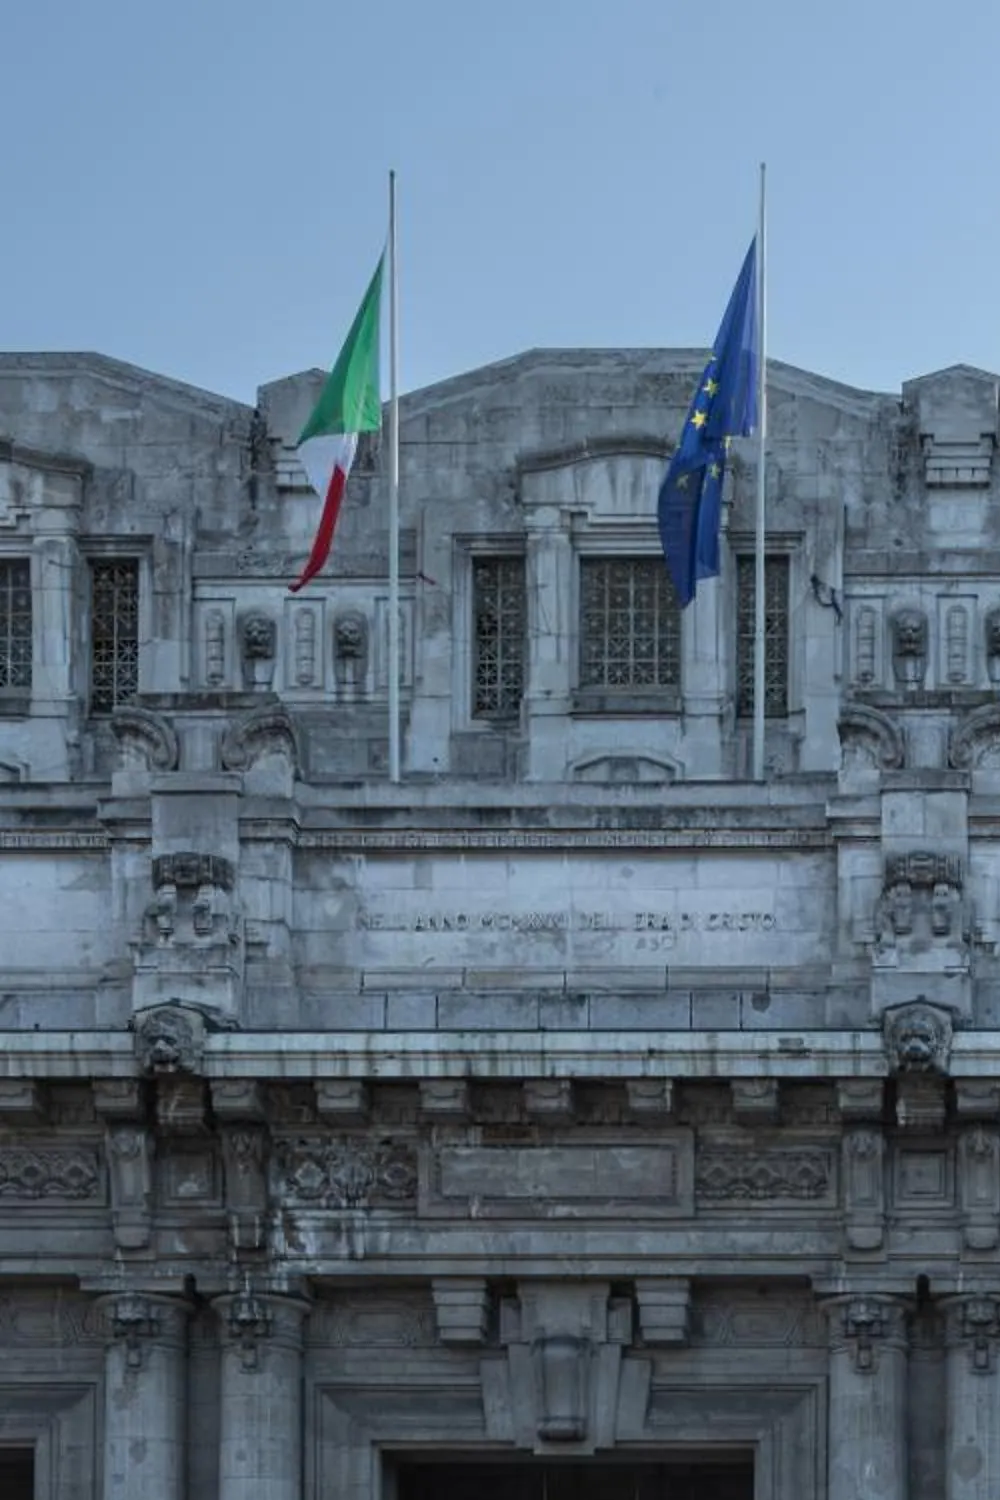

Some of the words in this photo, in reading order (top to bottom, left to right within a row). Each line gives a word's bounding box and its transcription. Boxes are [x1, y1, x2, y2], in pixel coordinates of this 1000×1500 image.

[414, 912, 470, 931] ANNO
[633, 912, 671, 931] ERA
[705, 912, 776, 931] CRISTO
